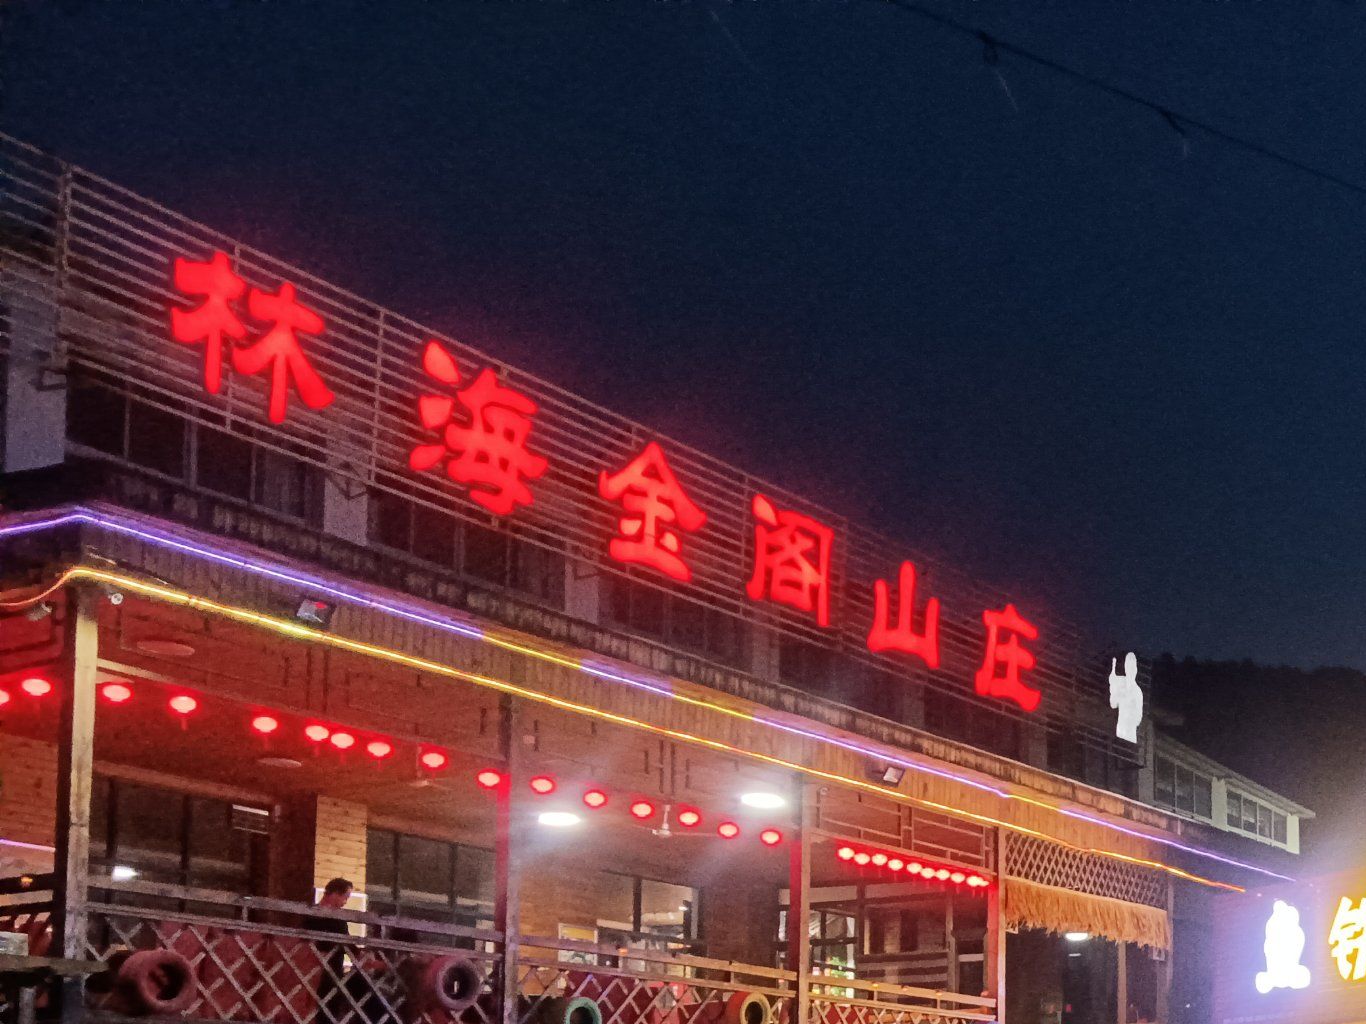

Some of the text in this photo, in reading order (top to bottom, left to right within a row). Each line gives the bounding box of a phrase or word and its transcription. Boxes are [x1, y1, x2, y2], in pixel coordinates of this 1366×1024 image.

[169, 250, 1041, 712] 林海金阁山庄
